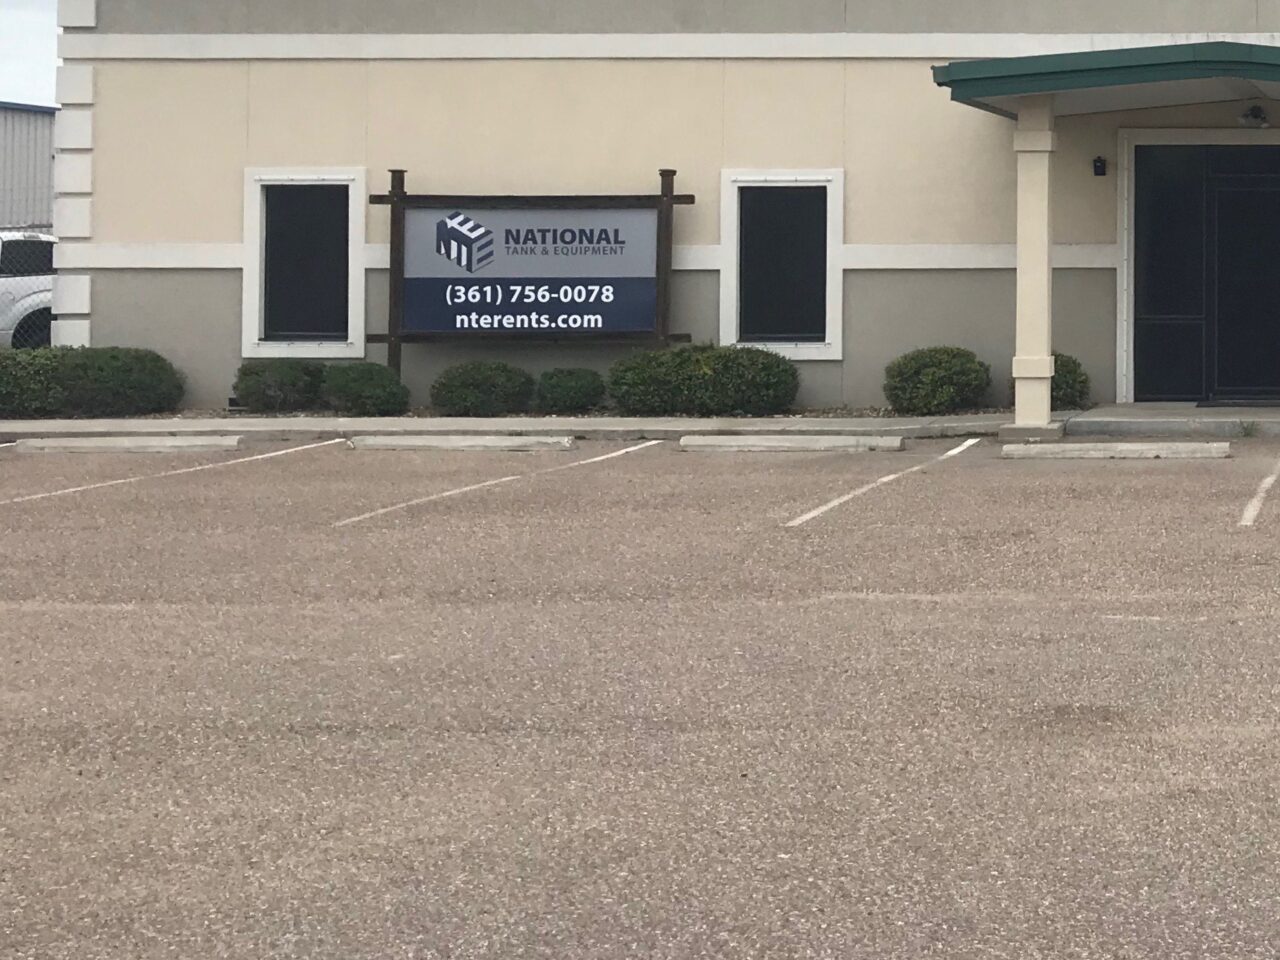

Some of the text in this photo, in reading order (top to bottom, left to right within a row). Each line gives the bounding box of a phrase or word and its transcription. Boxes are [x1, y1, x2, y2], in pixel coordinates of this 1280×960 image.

[504, 228, 626, 245] NATIONAL
[505, 246, 626, 256] TANK & EQUIPMENT
[445, 284, 615, 306] (361) 756-0078
[455, 311, 603, 328] nterents.com
